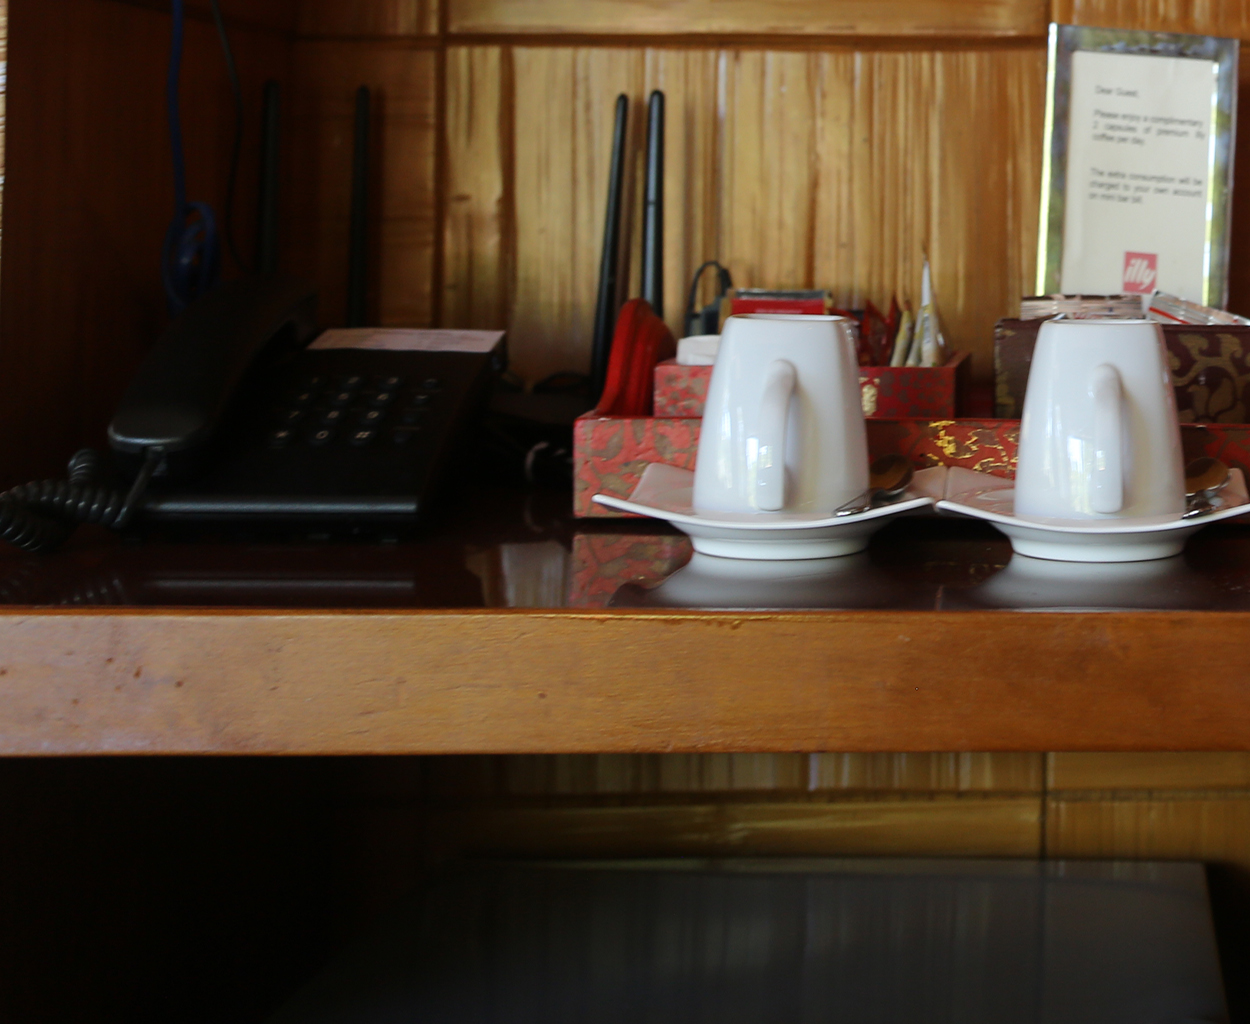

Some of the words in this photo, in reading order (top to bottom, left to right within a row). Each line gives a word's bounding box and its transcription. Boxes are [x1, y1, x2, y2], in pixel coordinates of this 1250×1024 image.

[1095, 85, 1112, 95] Dear
[1094, 109, 1119, 119] Please
[1121, 113, 1140, 123] enjoy
[1150, 116, 1203, 128] complimentary
[1104, 123, 1137, 133] capsules
[1143, 126, 1151, 134] of
[1155, 128, 1189, 137] premium
[1092, 133, 1115, 141] coffee
[1116, 136, 1128, 144] per
[1090, 167, 1105, 177] The
[1107, 171, 1126, 179] extra
[1129, 173, 1175, 184] consumption
[1178, 176, 1190, 185] will
[1193, 177, 1202, 186] be
[1089, 180, 1120, 191] charged
[1172, 188, 1203, 198] account
[1100, 192, 1115, 201] mini
[1117, 194, 1129, 203] bar
[1123, 257, 1156, 290] illy
